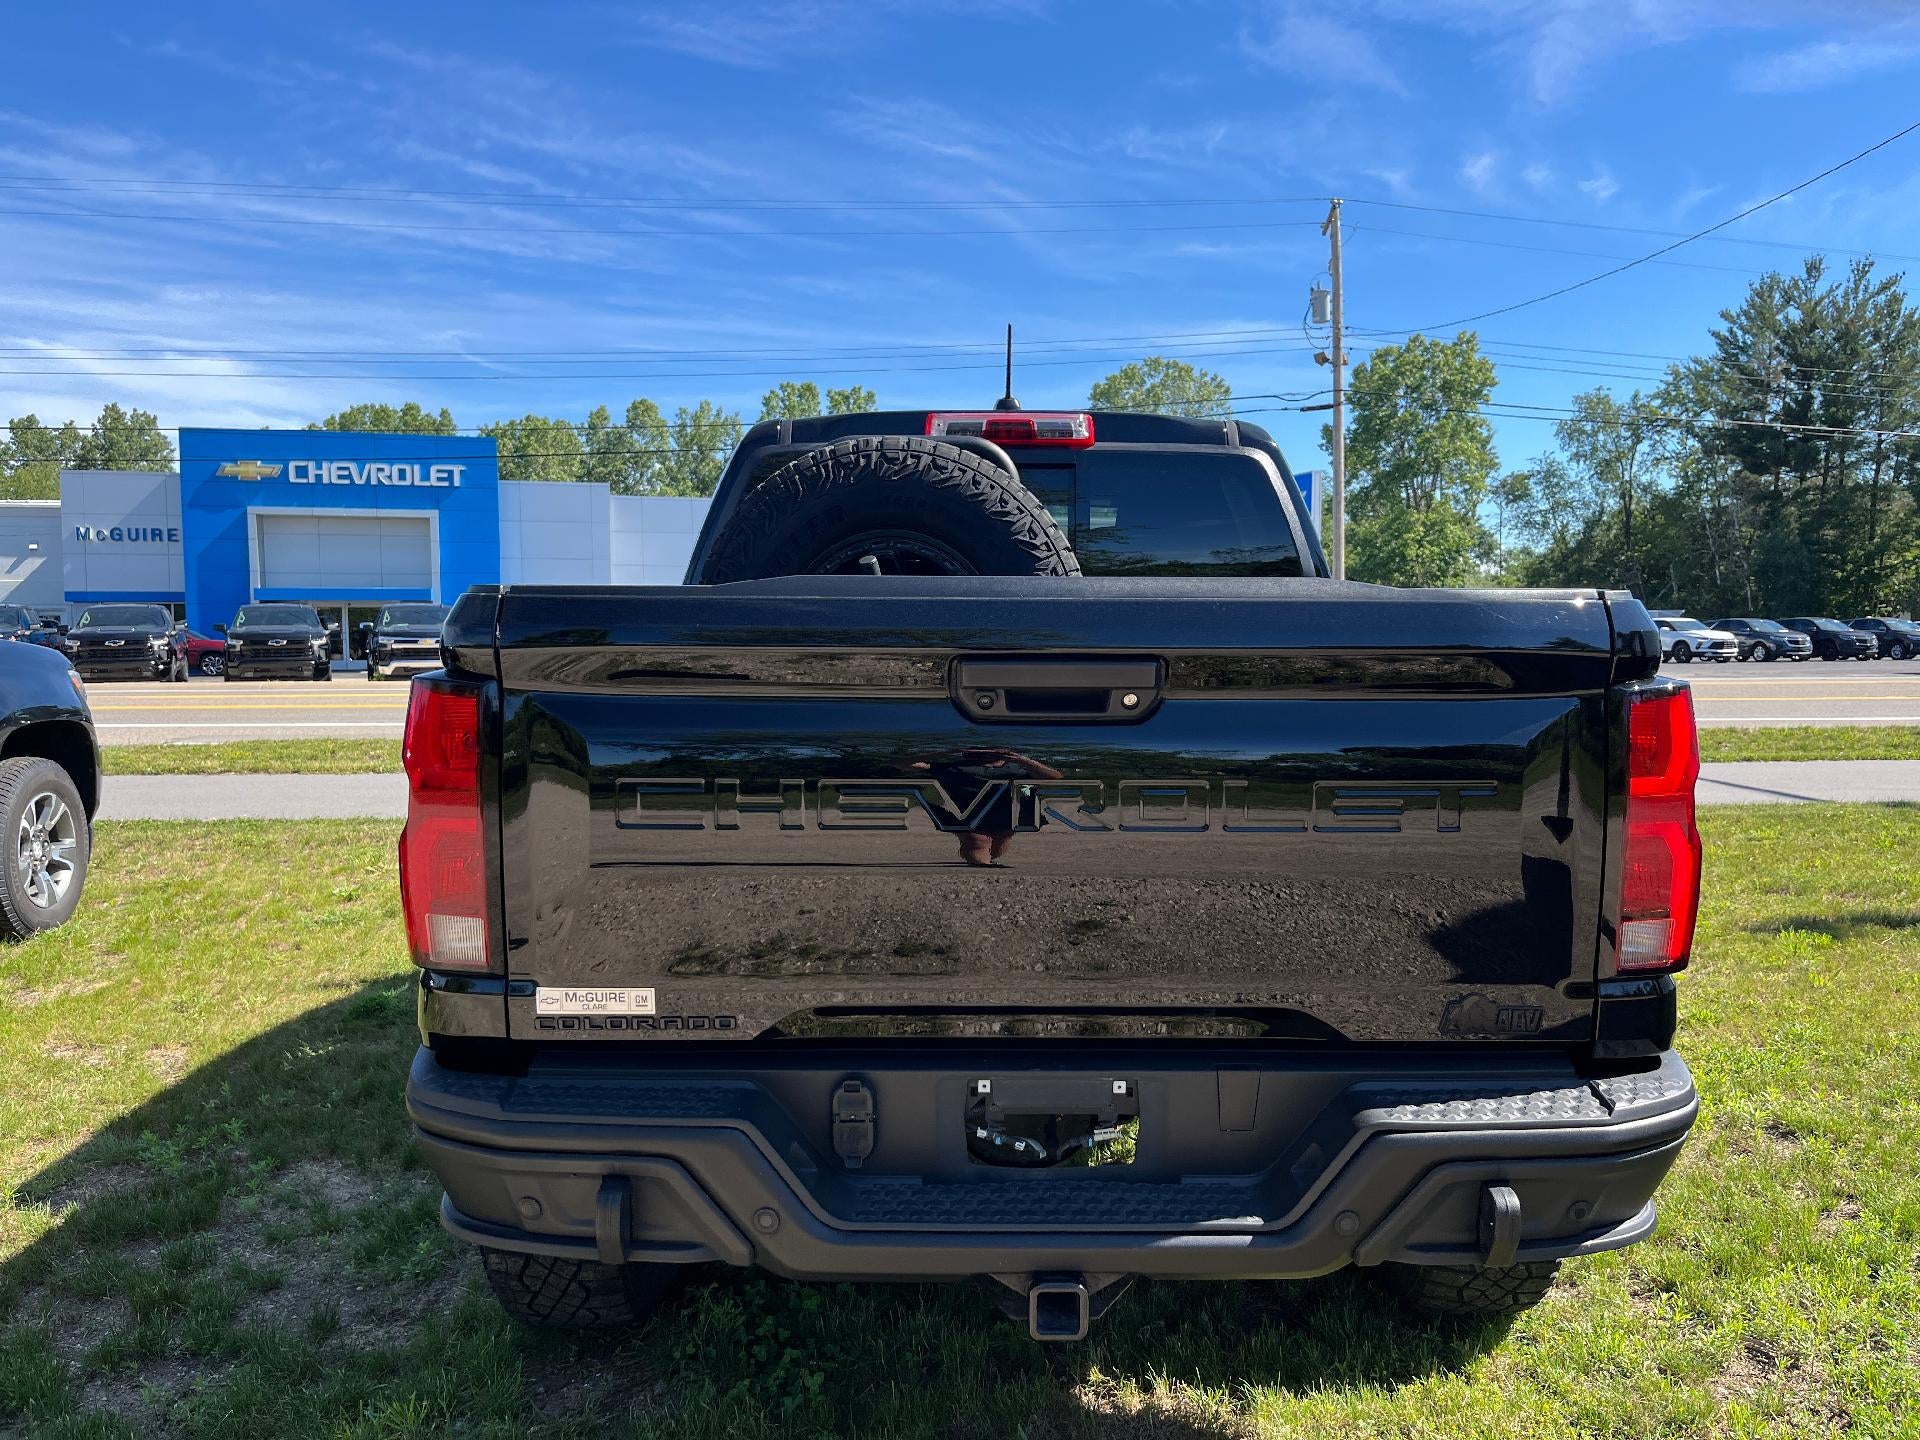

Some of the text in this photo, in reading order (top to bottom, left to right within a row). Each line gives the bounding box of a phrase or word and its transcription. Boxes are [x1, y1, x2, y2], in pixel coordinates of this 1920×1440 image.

[288, 460, 467, 487] CHEVROLET
[75, 526, 180, 542] McGUIRE
[614, 777, 1499, 831] CHEVROLET
[564, 991, 626, 1003] McGUIRE
[635, 994, 648, 1005] GM
[534, 1016, 737, 1031] COLORADO
